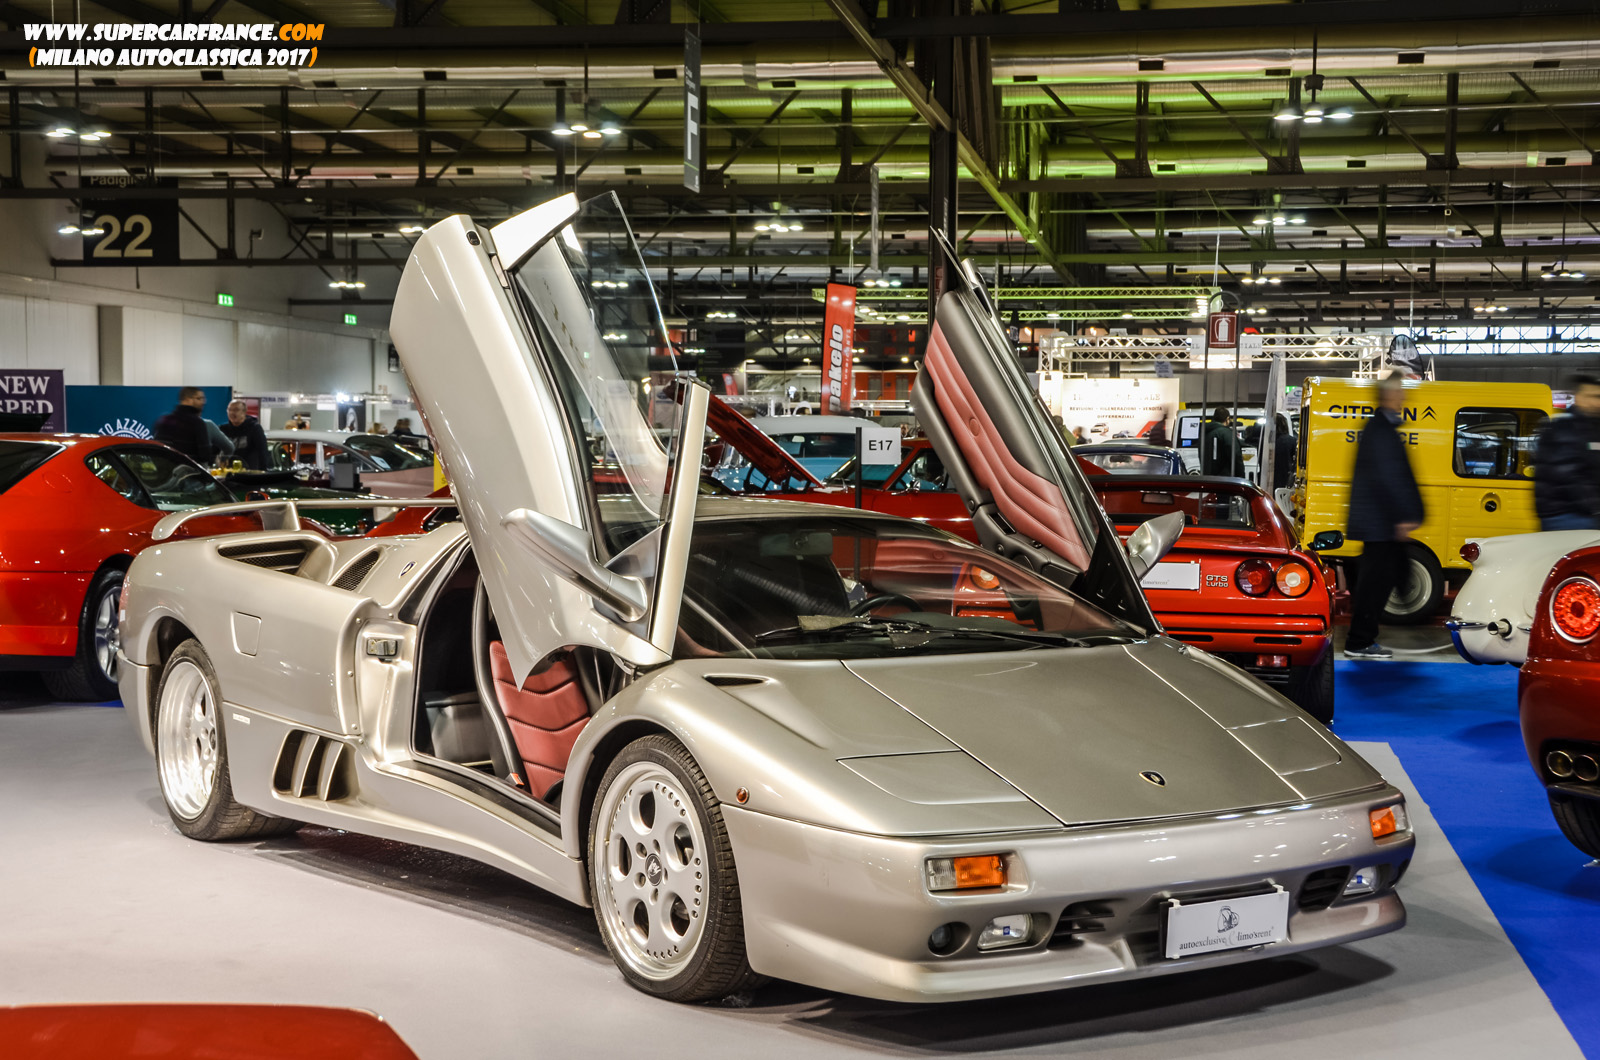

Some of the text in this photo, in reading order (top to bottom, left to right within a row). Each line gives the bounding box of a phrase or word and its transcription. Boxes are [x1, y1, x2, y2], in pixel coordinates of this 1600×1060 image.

[92, 214, 153, 258] 22
[0, 399, 54, 414] PED
[1328, 405, 1417, 421] CITRN
[868, 439, 893, 451] E17
[1205, 574, 1229, 582] GTS
[1179, 936, 1226, 950] autoexclusive
